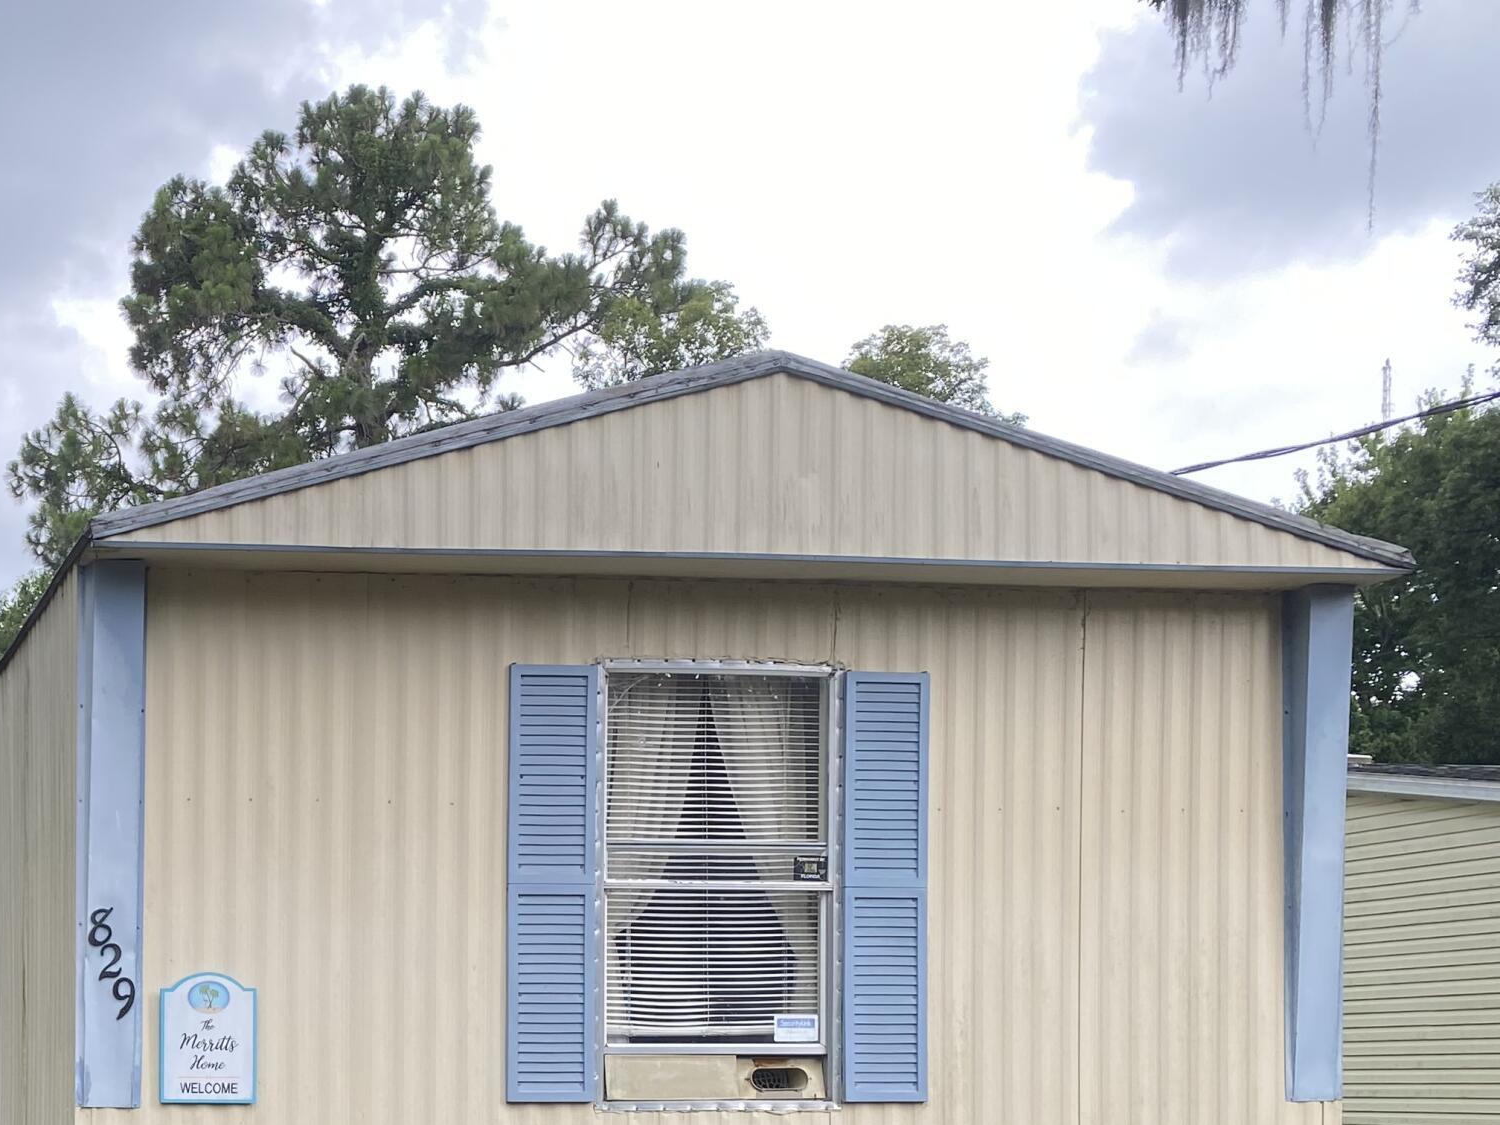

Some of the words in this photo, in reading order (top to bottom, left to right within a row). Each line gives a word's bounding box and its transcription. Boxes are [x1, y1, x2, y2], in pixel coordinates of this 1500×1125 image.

[88, 907, 136, 1021] 829
[200, 1018, 215, 1031] The
[179, 1032, 239, 1053] Merritts
[190, 1054, 226, 1071] Home
[179, 1082, 238, 1095] WELCOME
